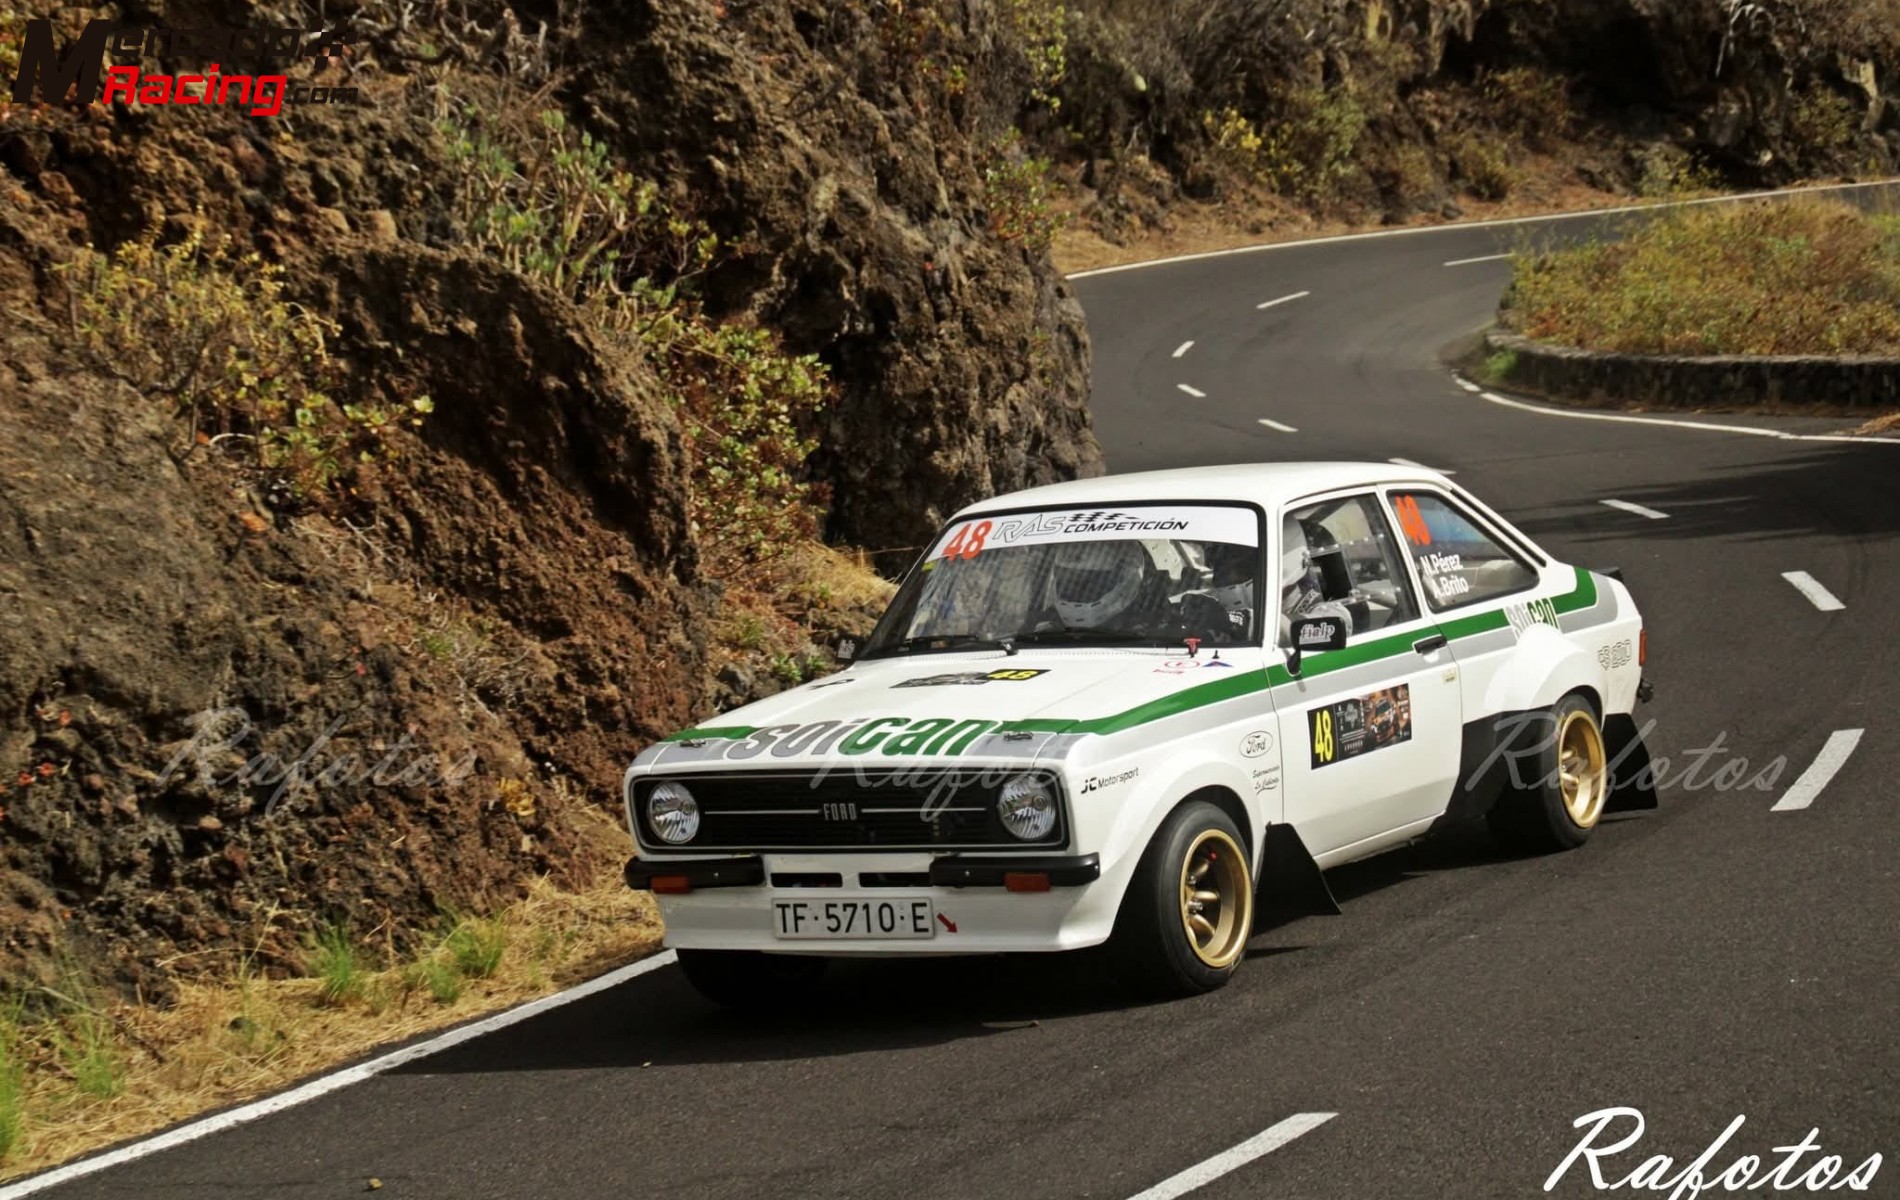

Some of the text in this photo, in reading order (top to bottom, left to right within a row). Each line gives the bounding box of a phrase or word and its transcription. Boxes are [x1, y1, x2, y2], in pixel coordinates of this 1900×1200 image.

[942, 514, 1189, 561] 48 RAS COMPETICIÓN
[1314, 709, 1334, 763] 48
[1097, 766, 1140, 789] Motorsport
[823, 803, 858, 821] FORD
